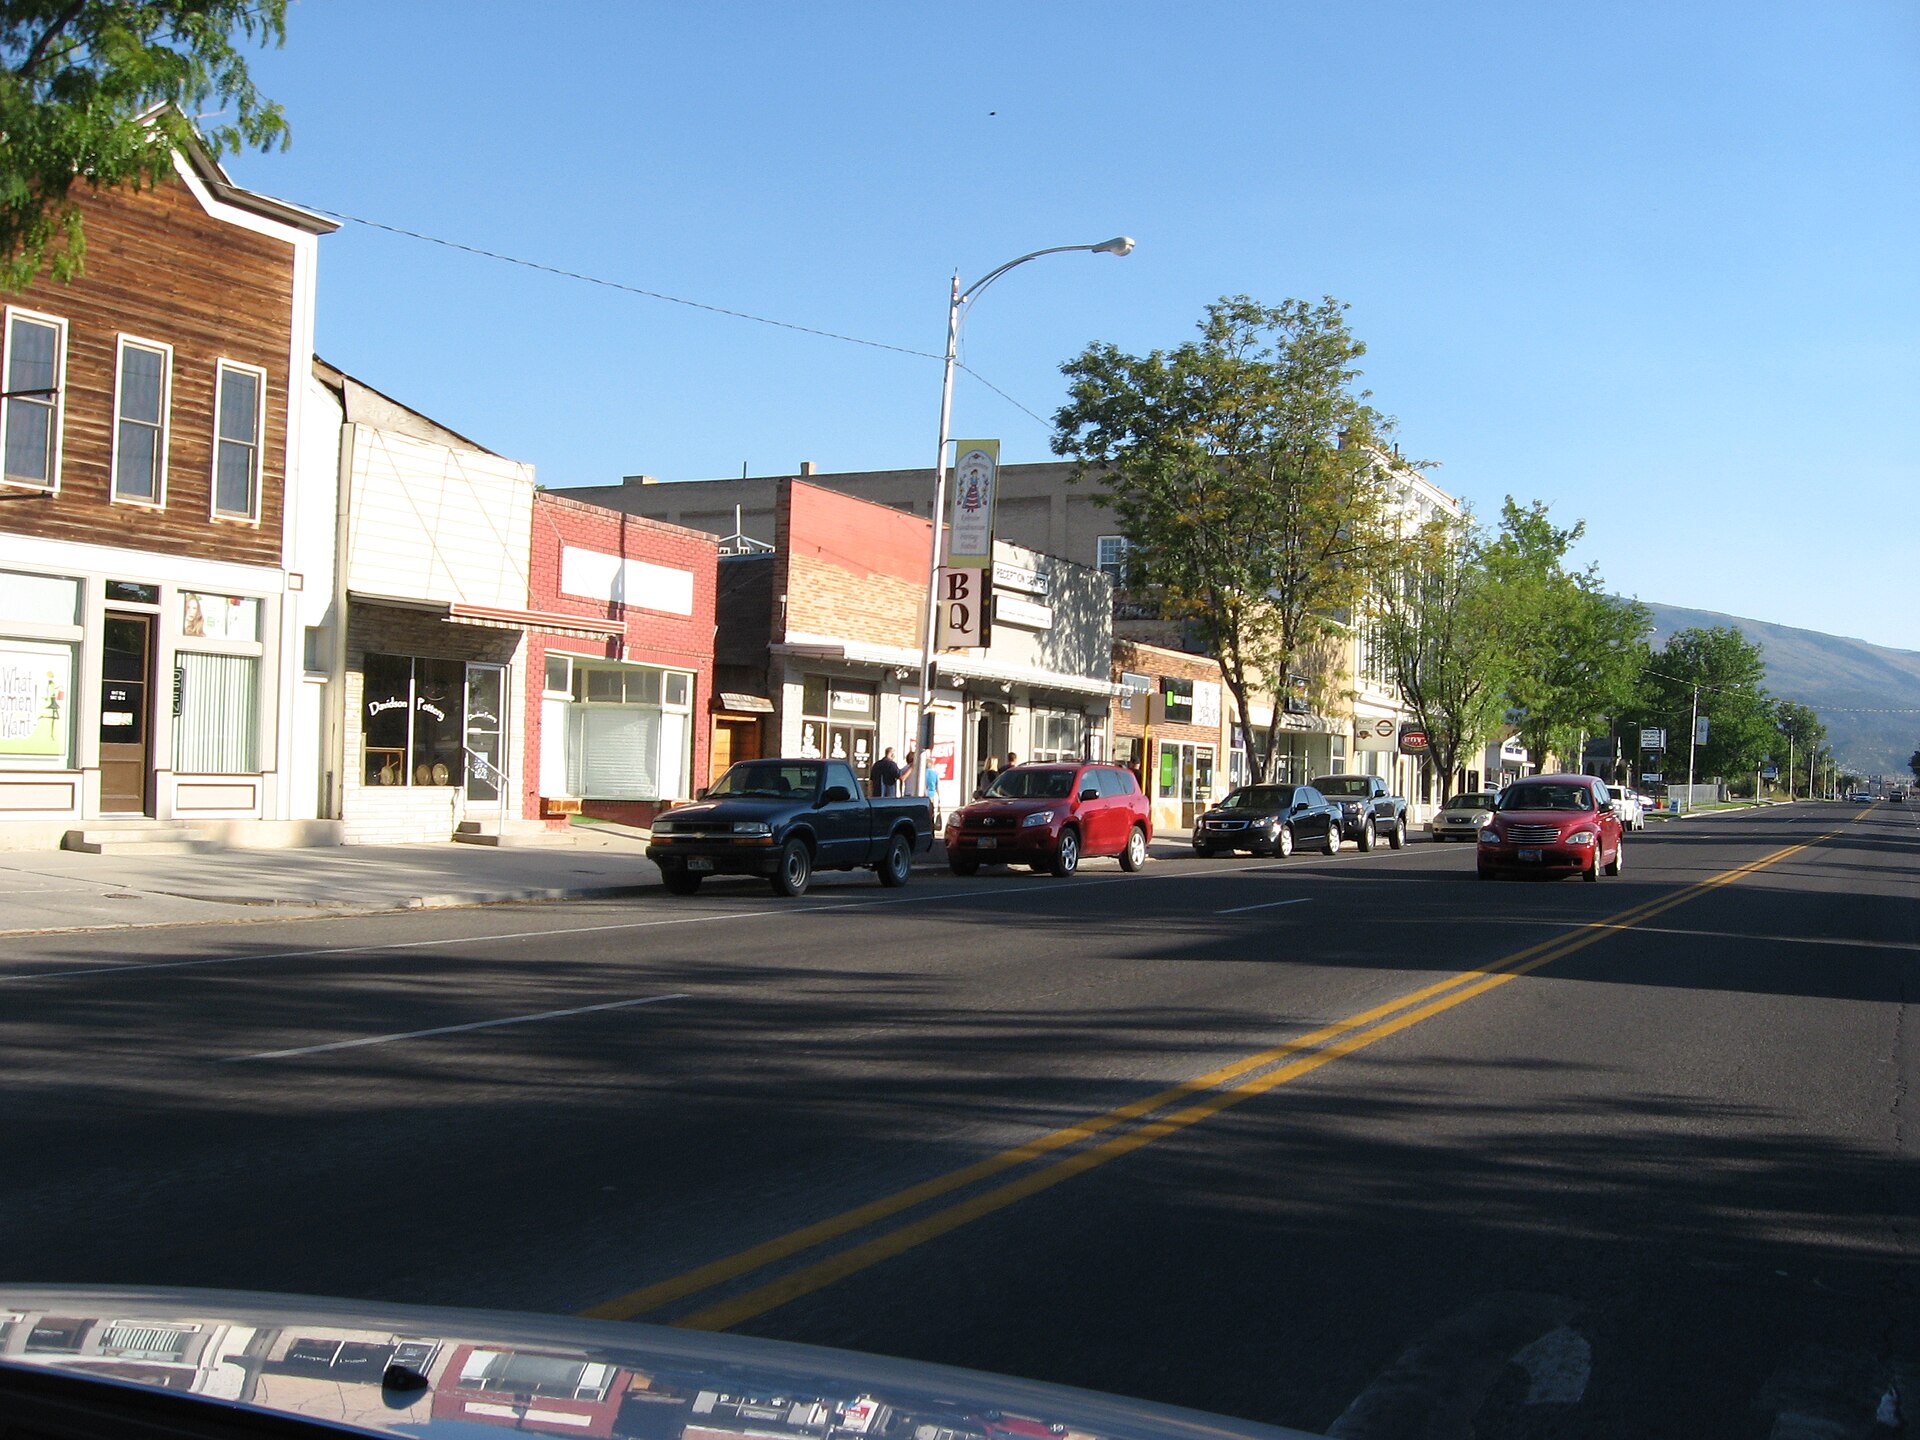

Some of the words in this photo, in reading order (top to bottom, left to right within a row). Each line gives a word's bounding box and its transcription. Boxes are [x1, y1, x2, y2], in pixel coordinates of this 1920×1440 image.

[2, 666, 32, 694] What
[0, 695, 32, 713] omen
[368, 697, 408, 717] Davidson
[416, 697, 445, 722] Pottery
